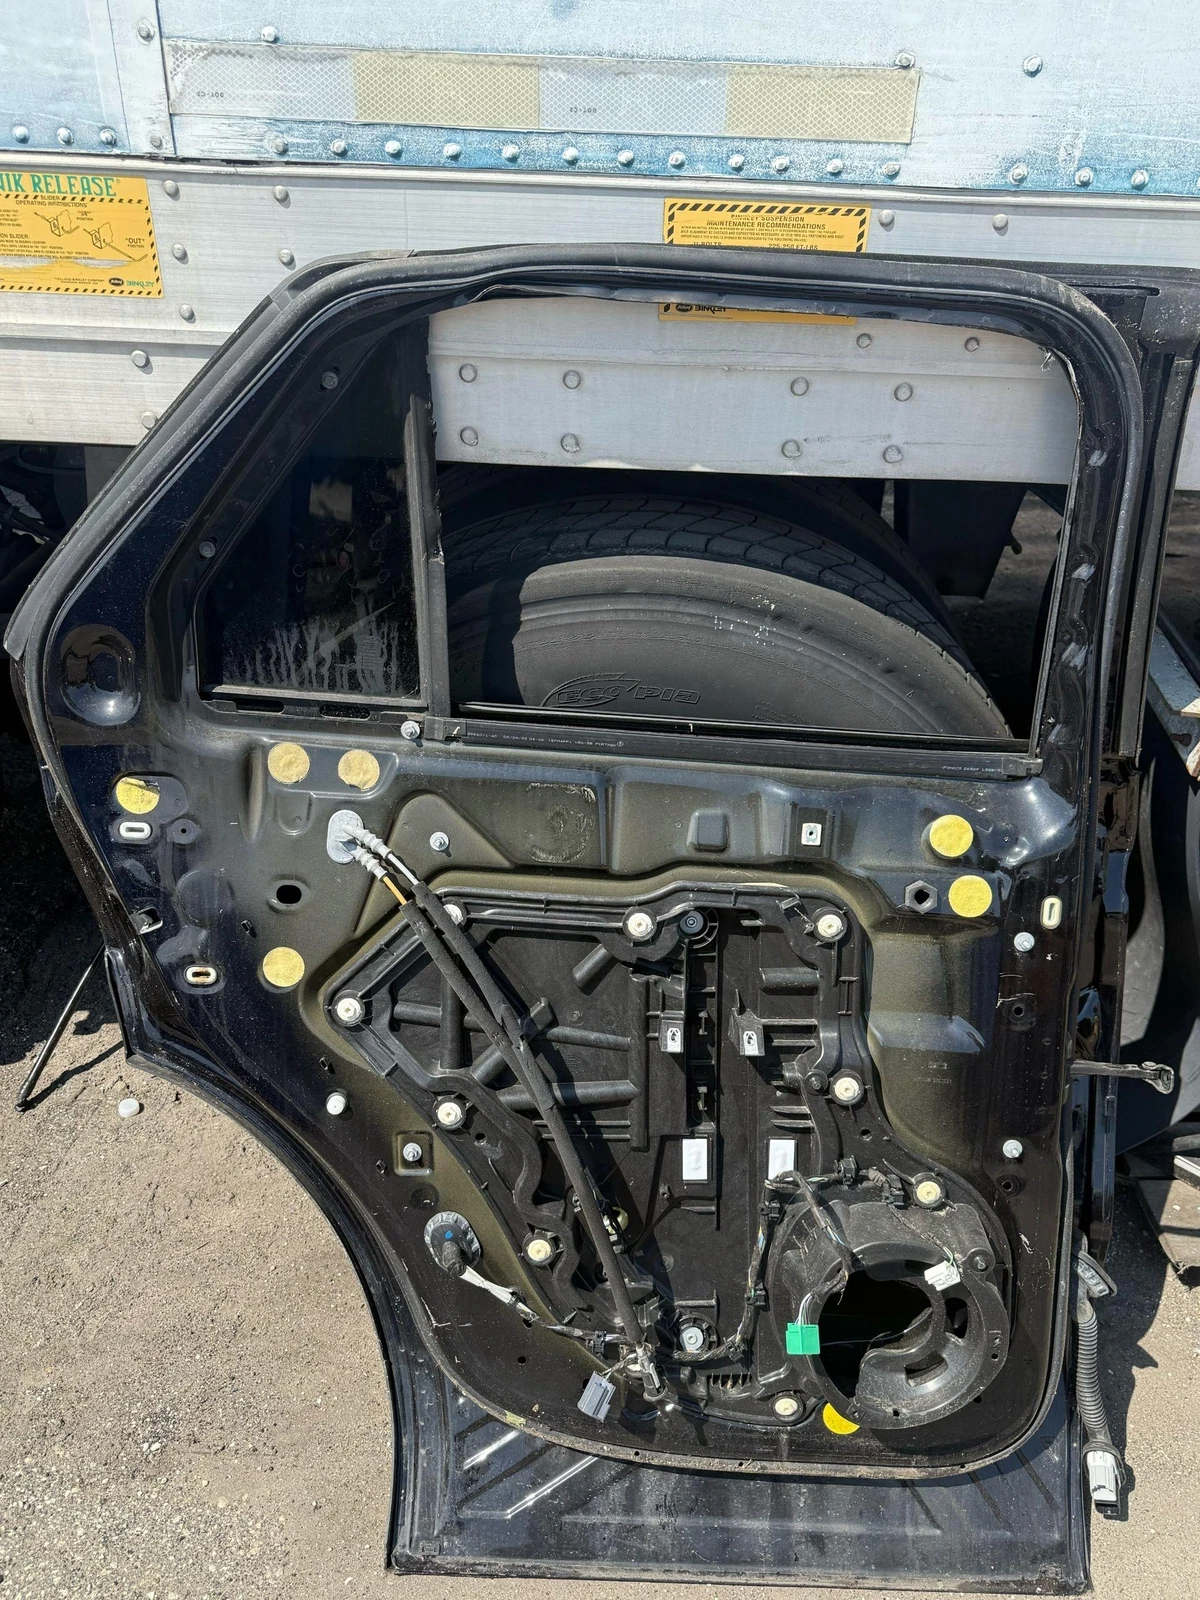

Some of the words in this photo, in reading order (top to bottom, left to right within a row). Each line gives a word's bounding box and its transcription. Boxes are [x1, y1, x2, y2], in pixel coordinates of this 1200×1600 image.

[40, 194, 61, 202] SLIDER
[15, 199, 47, 207] OPERATING
[707, 220, 755, 228] MAINTENANCE
[757, 221, 826, 230] RECOMMENDATIONS
